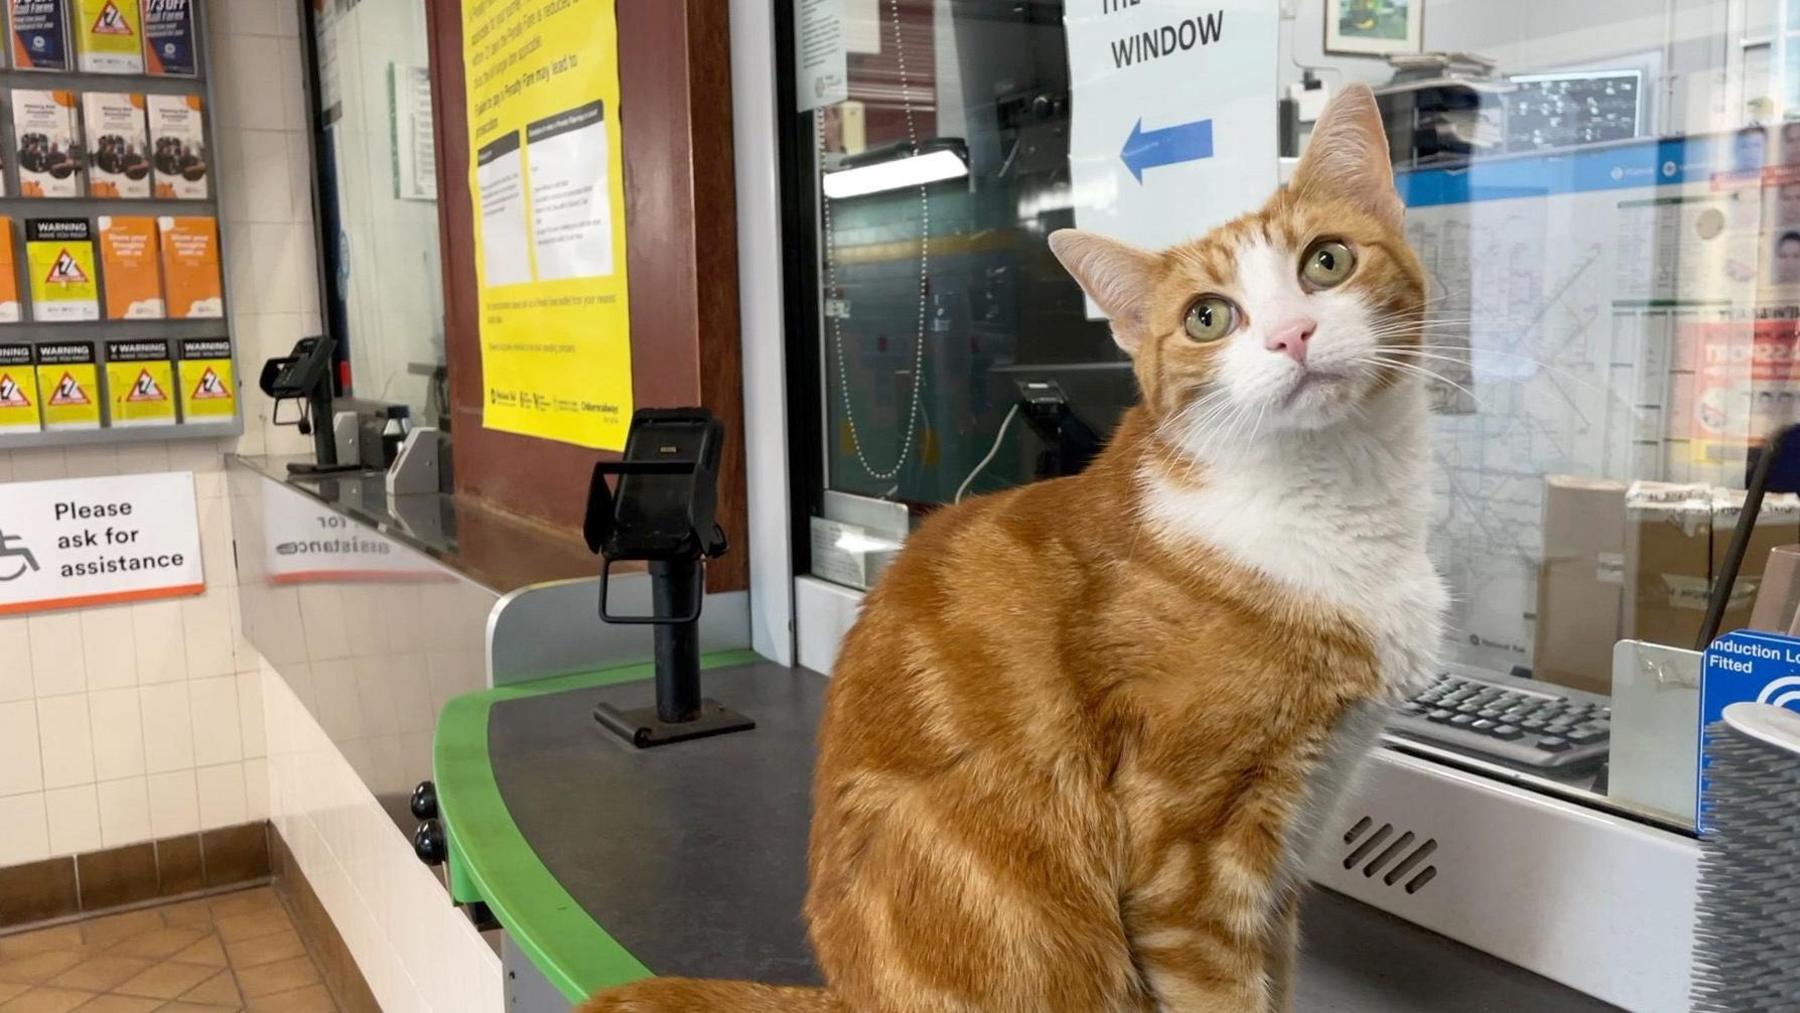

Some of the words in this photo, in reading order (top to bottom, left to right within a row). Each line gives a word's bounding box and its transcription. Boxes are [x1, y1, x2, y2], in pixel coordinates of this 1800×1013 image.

[1111, 10, 1223, 69] WINDOW
[55, 502, 132, 520] Please
[58, 529, 98, 549] ask
[105, 527, 139, 545] for
[61, 553, 184, 577] assistance
[1710, 654, 1753, 674] Fitted
